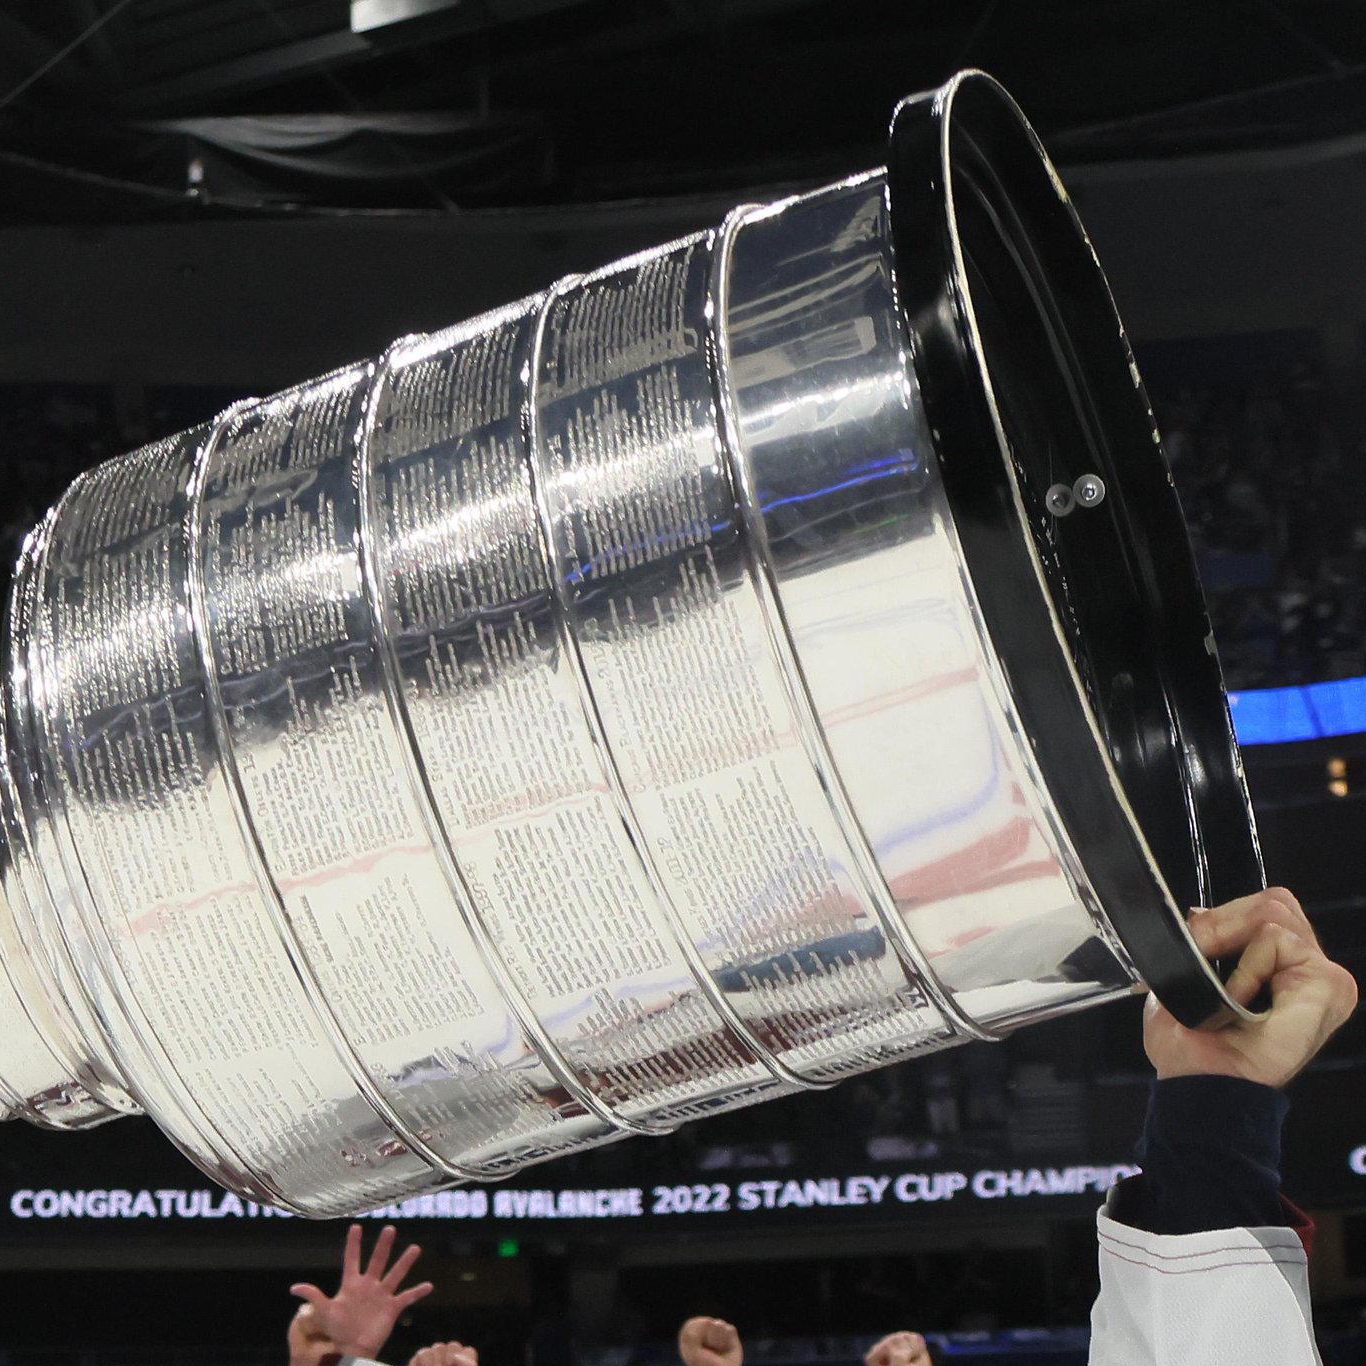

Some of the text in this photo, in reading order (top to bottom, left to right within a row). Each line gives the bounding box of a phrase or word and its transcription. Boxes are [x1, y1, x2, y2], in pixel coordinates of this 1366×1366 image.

[10, 1188, 295, 1219] CONGRATULA
[651, 1183, 731, 1214] 2022
[737, 1176, 890, 1210] STANLEY
[894, 1171, 968, 1202] CUP
[971, 1163, 1143, 1199] CHAMPIO
